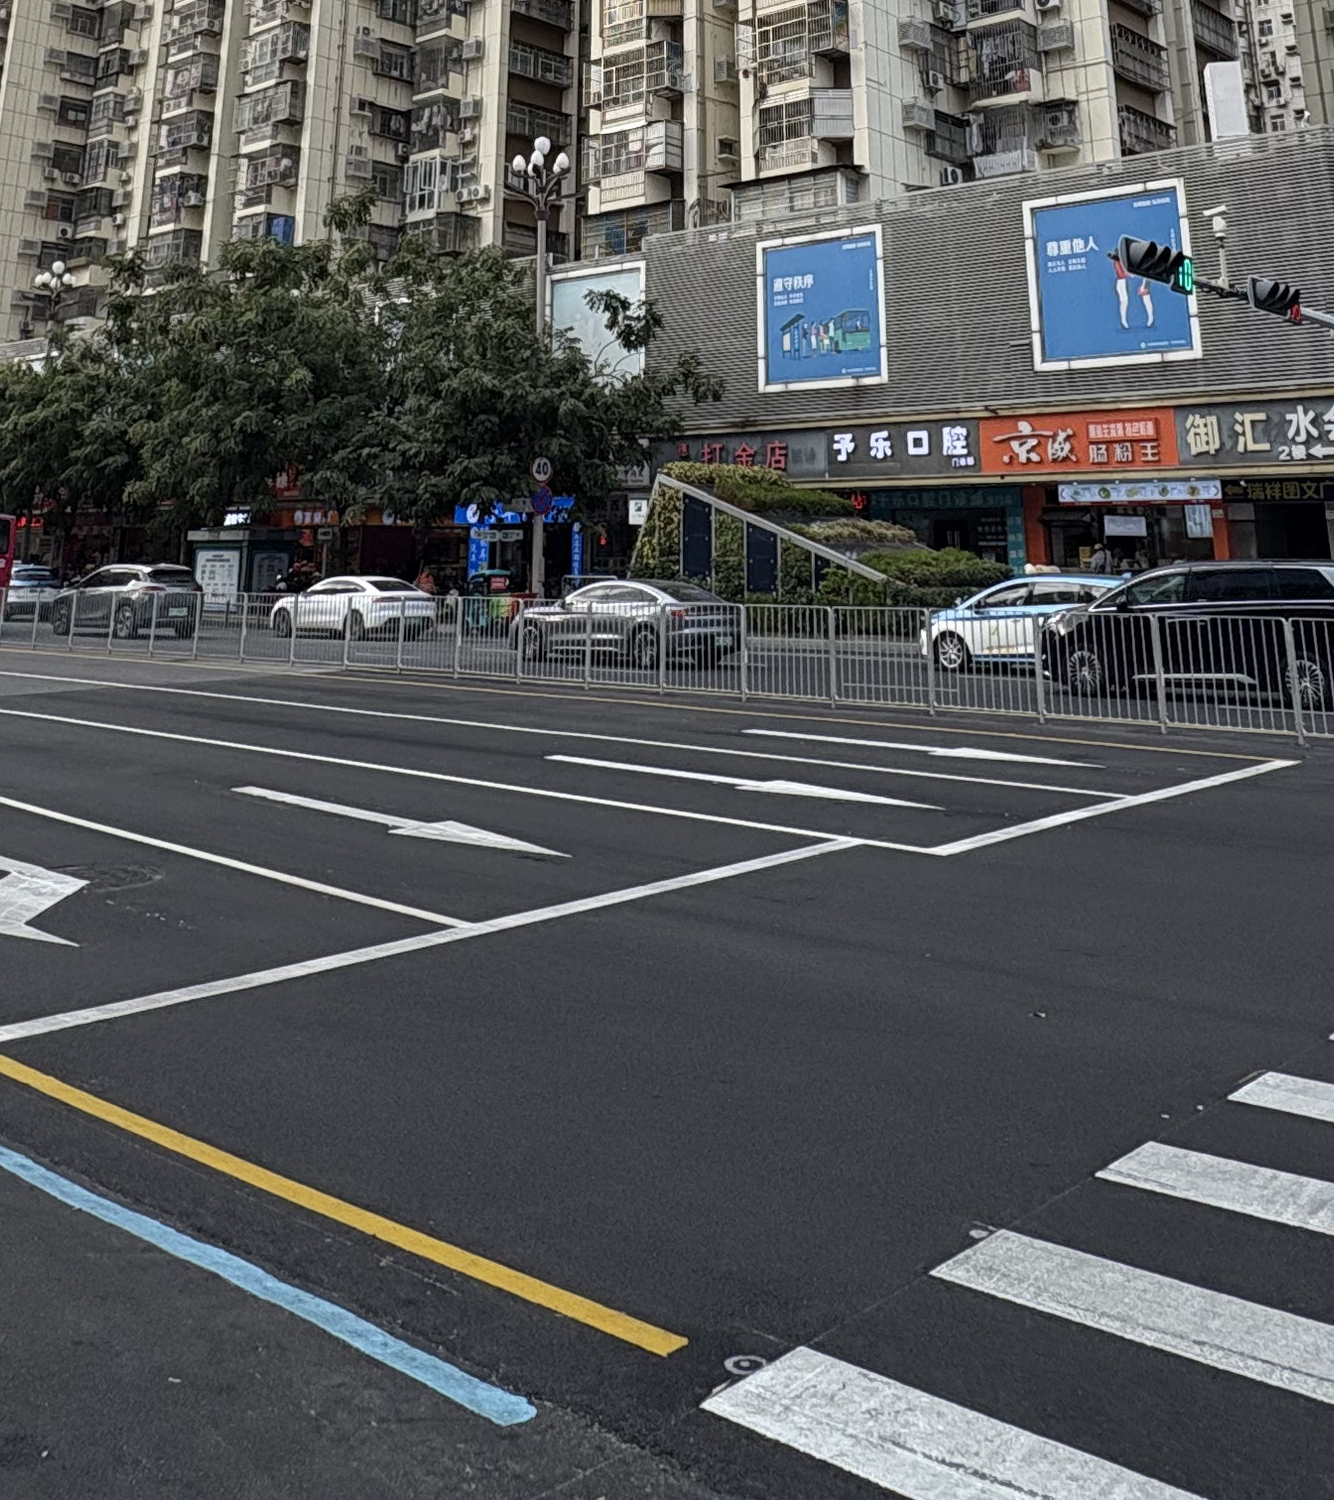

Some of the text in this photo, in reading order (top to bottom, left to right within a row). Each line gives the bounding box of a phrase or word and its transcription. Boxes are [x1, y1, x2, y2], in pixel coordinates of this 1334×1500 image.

[1046, 236, 1099, 257] 尊重他人
[1179, 258, 1193, 292] 10
[833, 426, 968, 462] 予乐口腔
[1089, 442, 1159, 463] 肠粉王
[535, 462, 549, 476] 40
